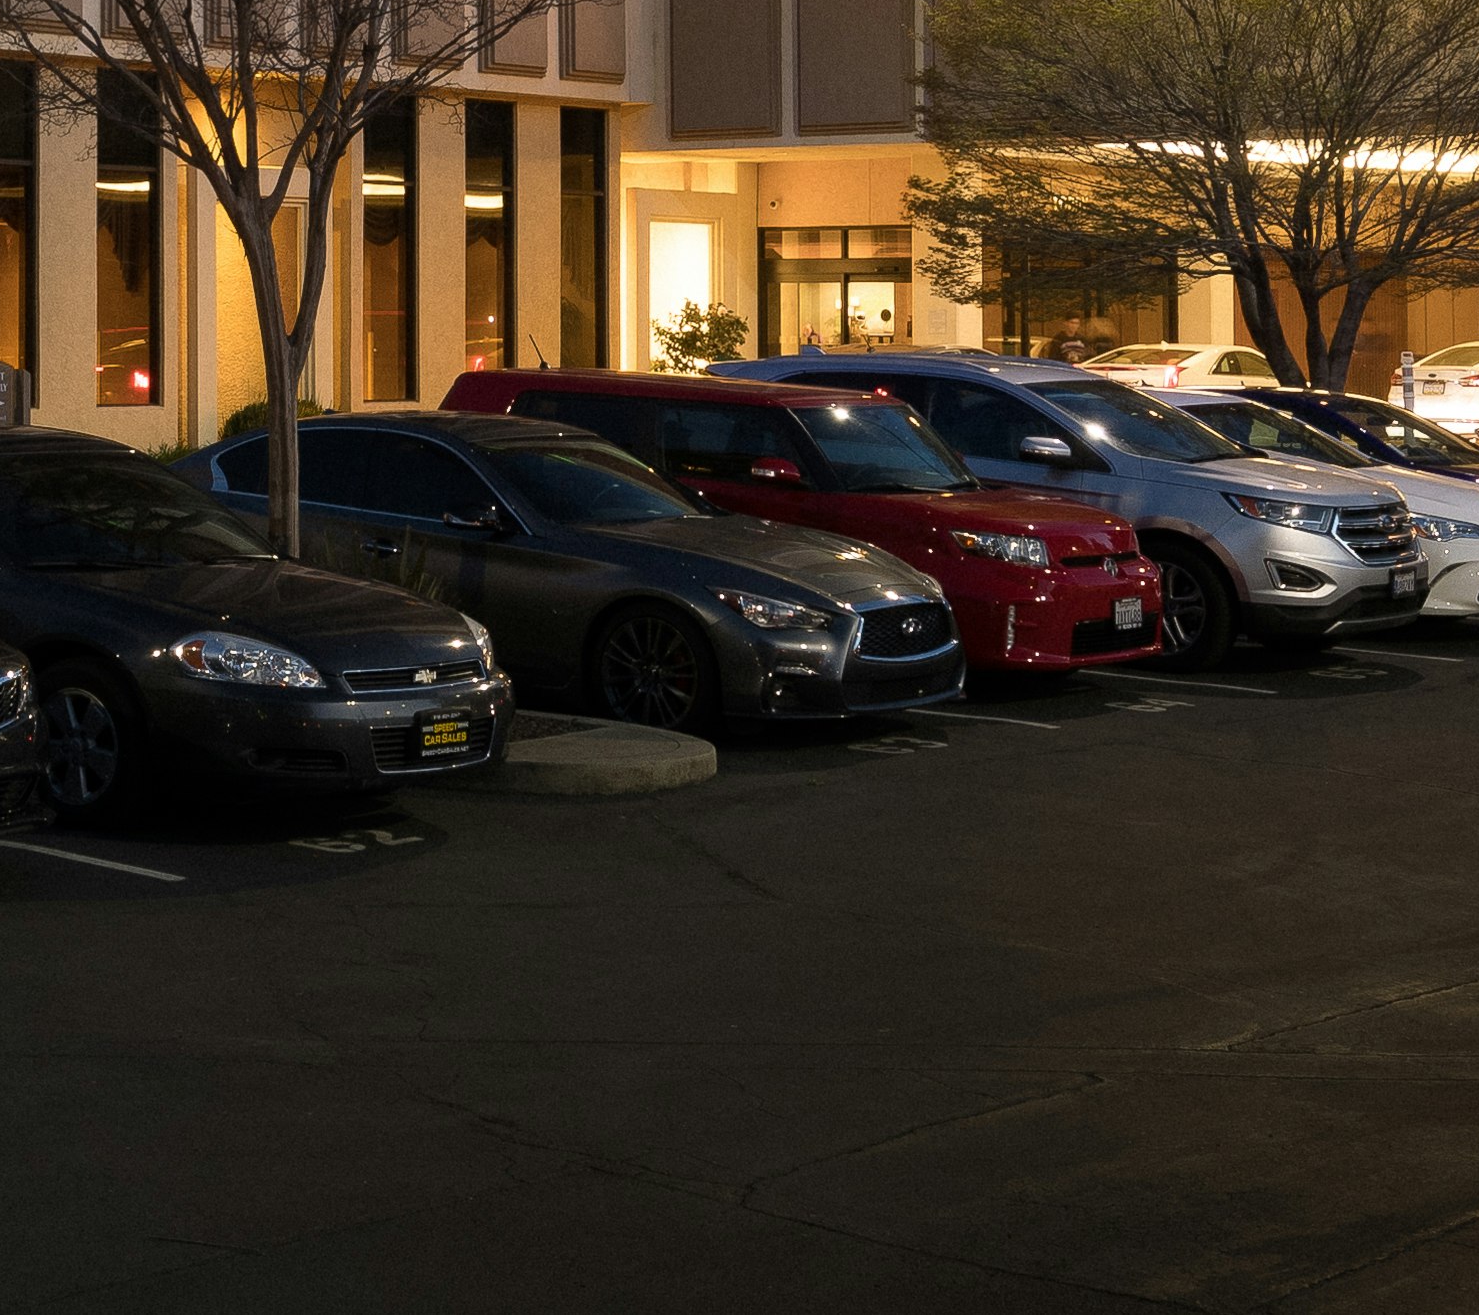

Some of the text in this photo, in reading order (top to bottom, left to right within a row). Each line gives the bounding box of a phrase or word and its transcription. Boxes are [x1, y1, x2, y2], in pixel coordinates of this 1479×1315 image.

[433, 722, 457, 733] SPEEDY
[847, 737, 949, 754] 63
[287, 829, 425, 853] 62
